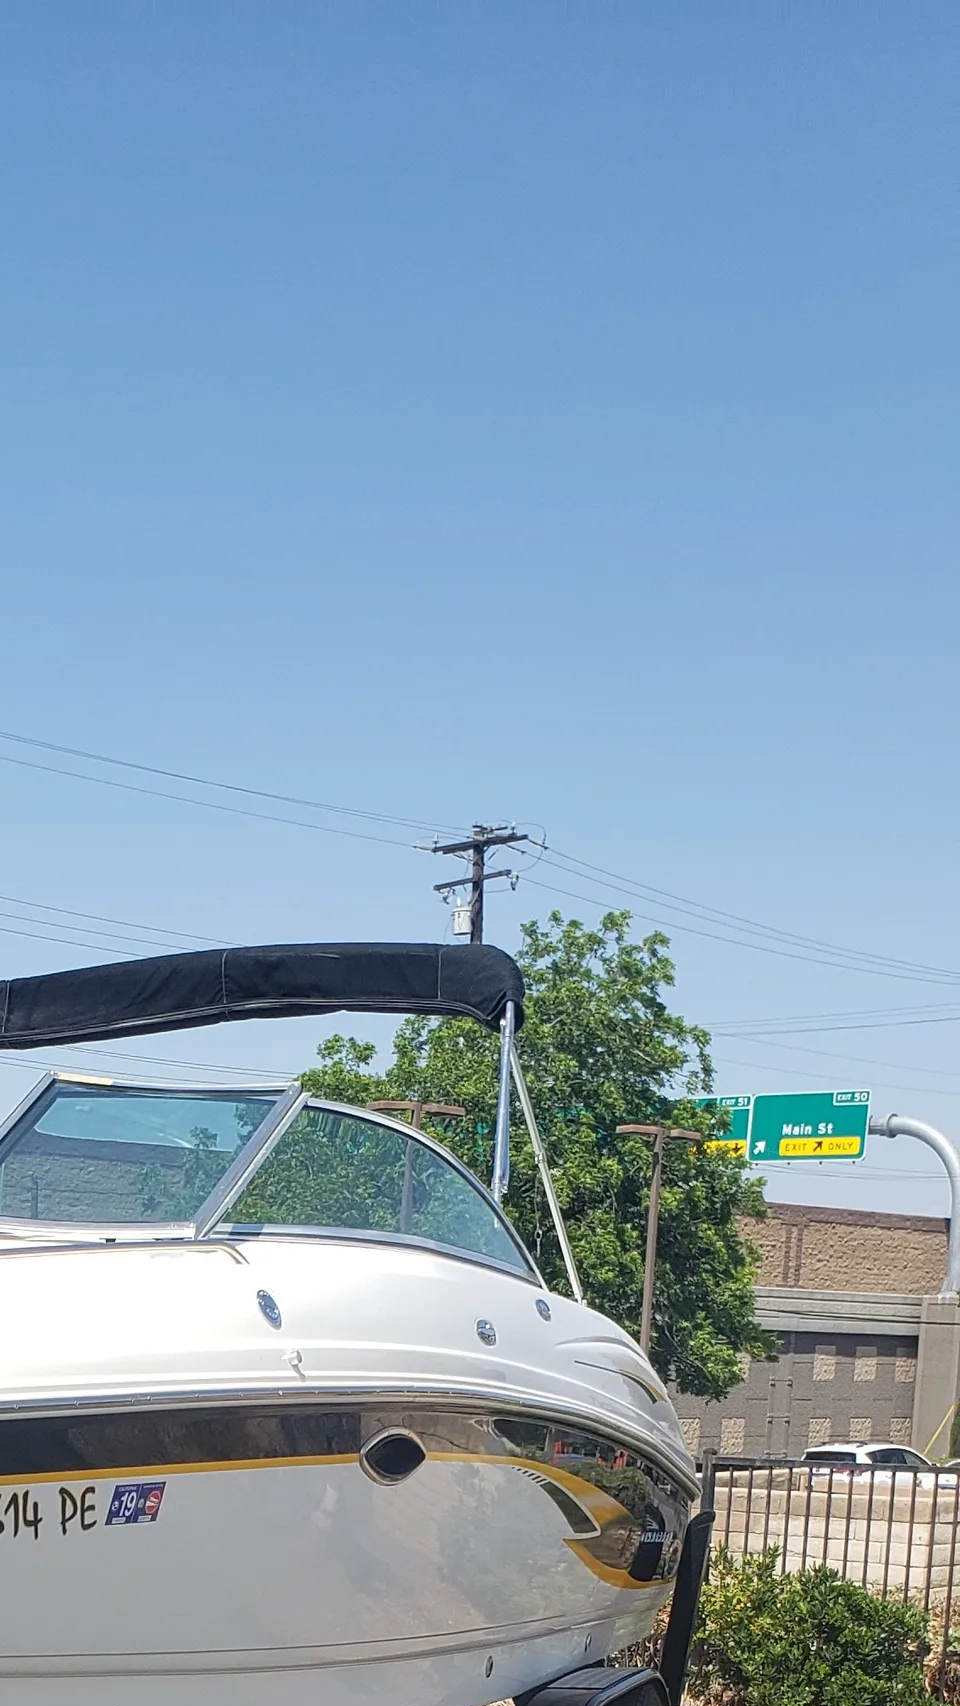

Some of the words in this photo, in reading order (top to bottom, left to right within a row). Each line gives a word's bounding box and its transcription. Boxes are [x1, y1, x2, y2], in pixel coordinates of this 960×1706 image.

[737, 1097, 748, 1106] 51
[837, 1093, 852, 1101] EXIT
[853, 1092, 868, 1102] 50
[781, 1123, 812, 1136] Main
[817, 1122, 834, 1134] St
[785, 1143, 807, 1152] EXIT
[828, 1142, 854, 1151] ONLY
[119, 1491, 137, 1517] 19
[58, 1486, 97, 1536] PE
